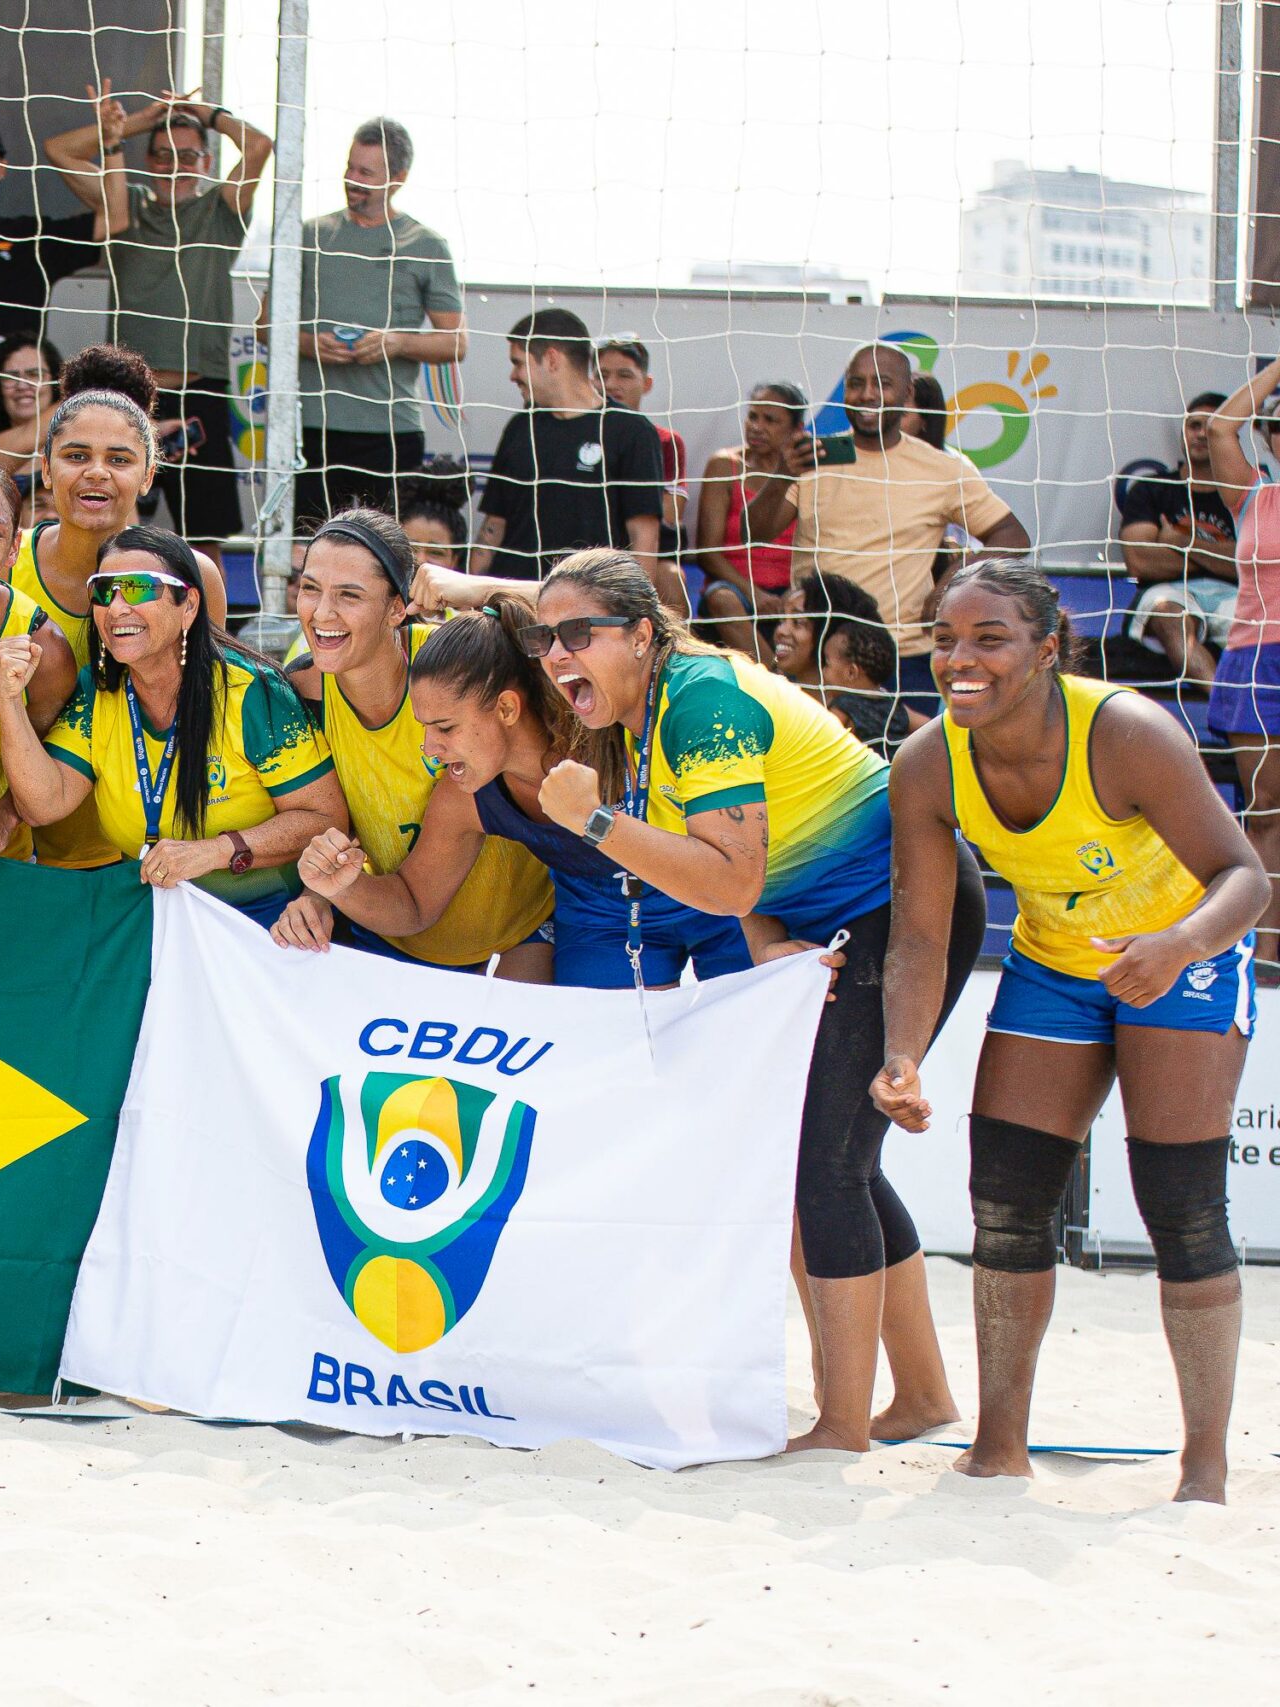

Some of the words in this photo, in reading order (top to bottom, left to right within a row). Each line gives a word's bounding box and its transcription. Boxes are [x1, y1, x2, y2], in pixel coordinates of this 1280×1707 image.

[207, 755, 222, 763] BDU
[207, 795, 231, 806] BRASIL
[398, 822, 422, 853] 7
[1182, 990, 1214, 1002] BRASIL
[358, 1017, 555, 1077] CBDU
[306, 1351, 517, 1421] BRASIL
